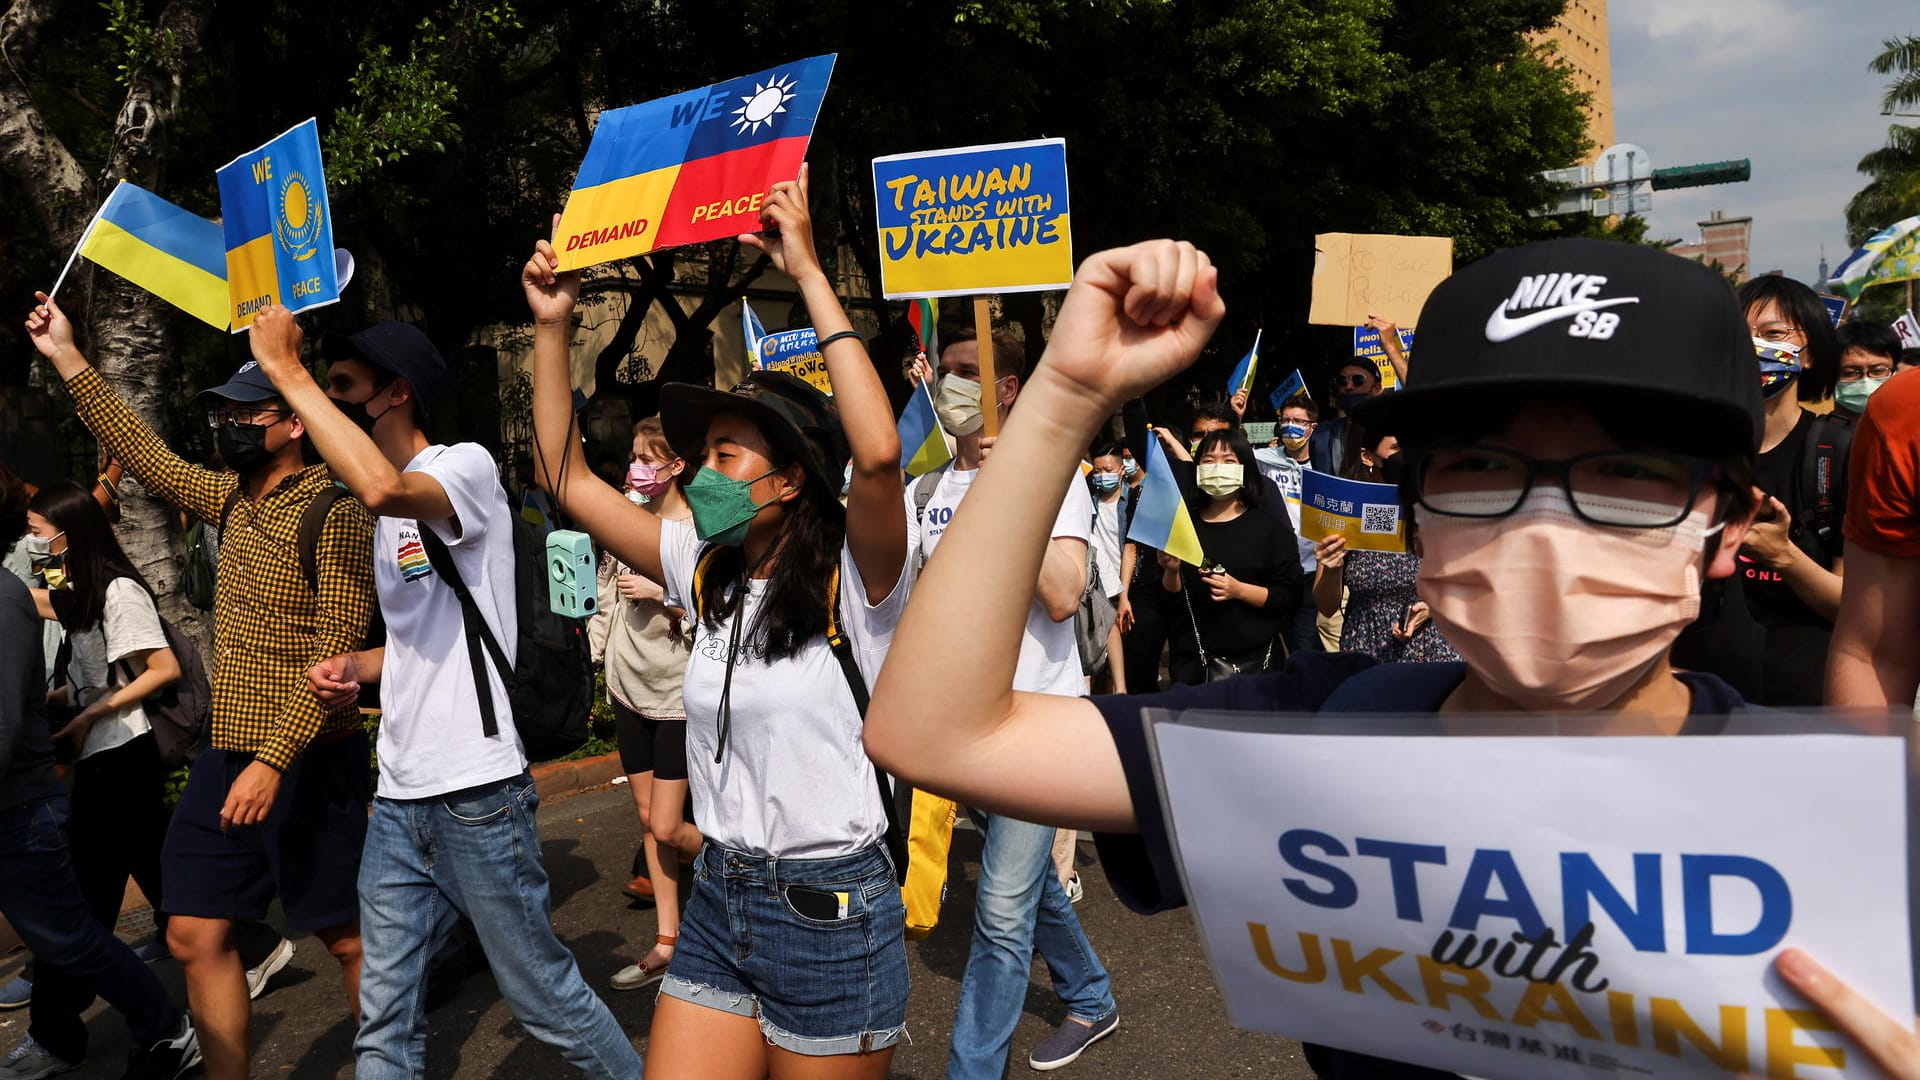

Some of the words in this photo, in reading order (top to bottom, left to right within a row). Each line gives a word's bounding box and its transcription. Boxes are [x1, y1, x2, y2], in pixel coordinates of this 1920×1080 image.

[670, 91, 730, 129] WE
[252, 156, 273, 185] WE
[886, 162, 1032, 210] TAIWAN
[566, 219, 648, 251] DEMAND
[691, 192, 765, 224] PEACE
[910, 201, 988, 226] STANDS
[995, 193, 1052, 216] WITH
[886, 215, 1059, 261] UKRAINE
[237, 294, 272, 318] DEMAND
[292, 277, 320, 299] PEACE
[1506, 272, 1608, 310] NIKE
[1568, 310, 1620, 340] SB
[1356, 345, 1384, 356] Beliz
[1313, 493, 1354, 514] 烏克蘭
[1278, 829, 1793, 956] STAND
[1430, 918, 1609, 993] with
